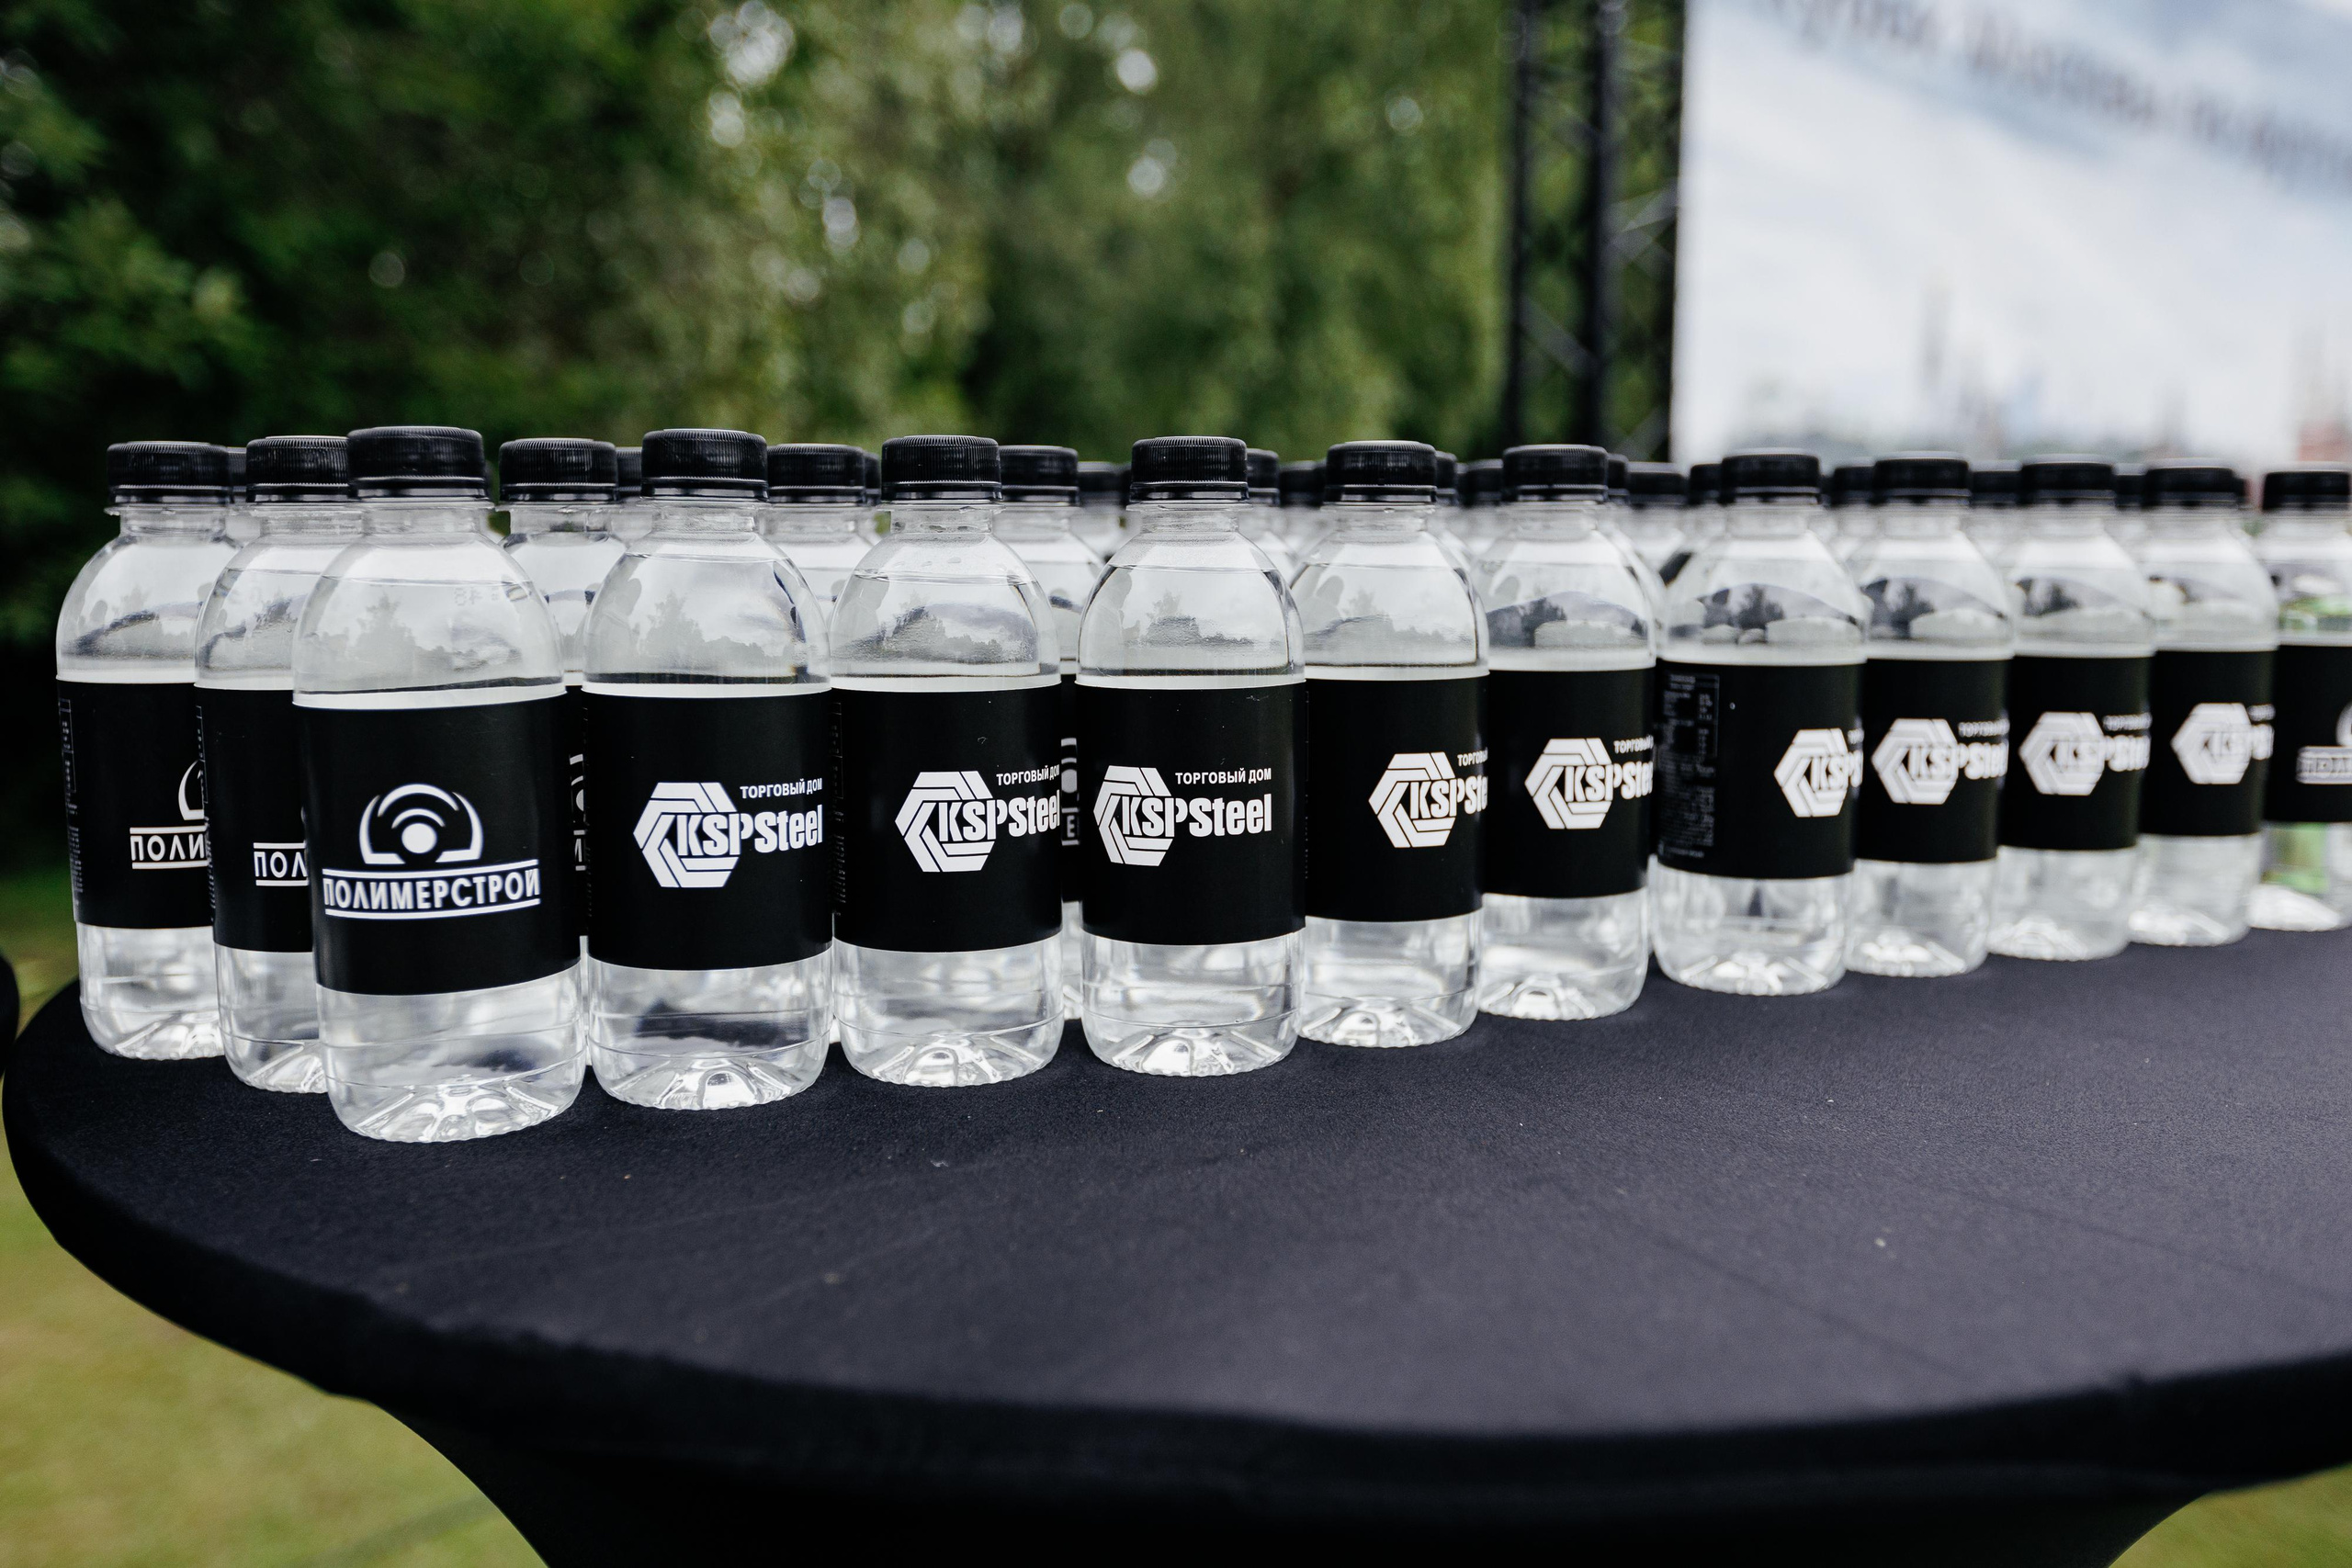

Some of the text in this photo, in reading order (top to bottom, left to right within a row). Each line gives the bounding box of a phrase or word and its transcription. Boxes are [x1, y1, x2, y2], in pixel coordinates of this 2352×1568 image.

[996, 765, 1049, 786] ТОРГОВЫЙ
[1175, 767, 1272, 785] ТОРГОВЫЙ ДОМ
[740, 777, 823, 799] ТОРГОВЫЙ ДОМ
[322, 867, 541, 910] ПОЛИМЕРСТРОЙ
